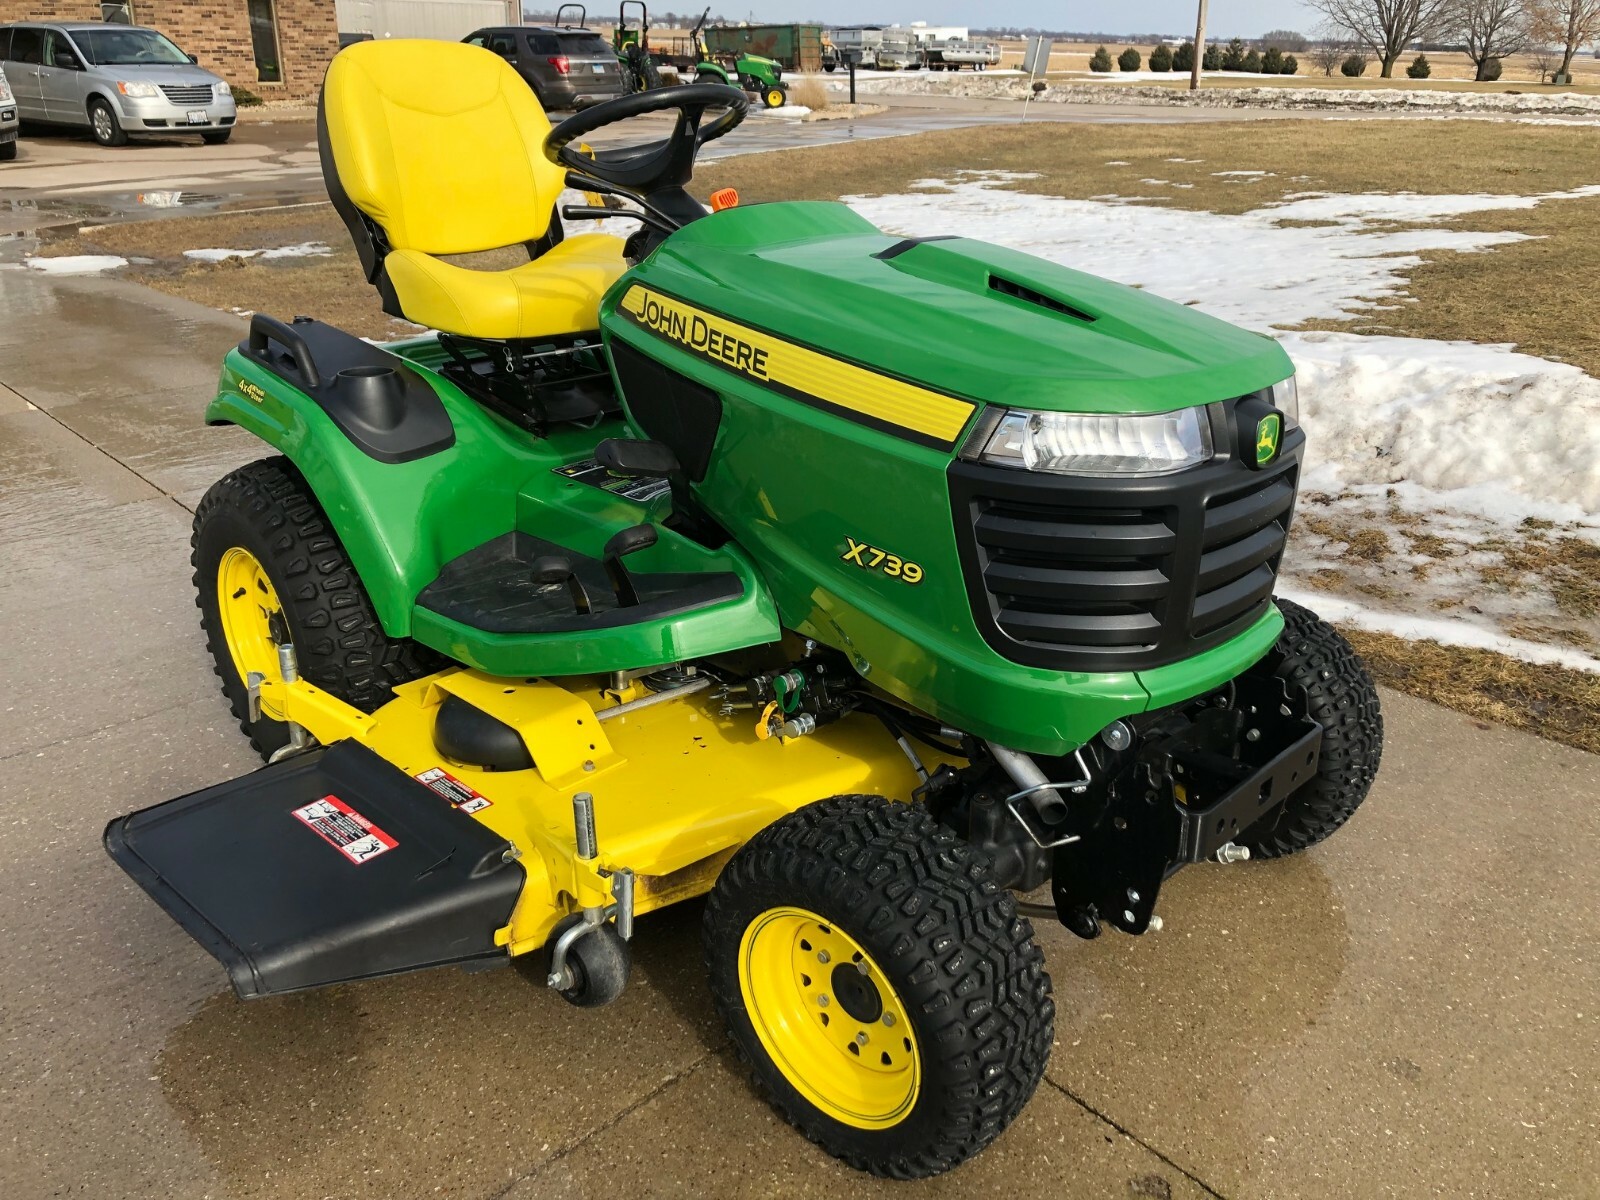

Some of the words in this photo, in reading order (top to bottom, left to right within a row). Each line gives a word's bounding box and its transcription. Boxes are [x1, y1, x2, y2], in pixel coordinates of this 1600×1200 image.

[636, 292, 687, 341] JOHN
[691, 315, 769, 378] DEERE
[239, 379, 252, 395] 4x4
[841, 537, 924, 584] X739
[352, 813, 373, 829] DANGER
